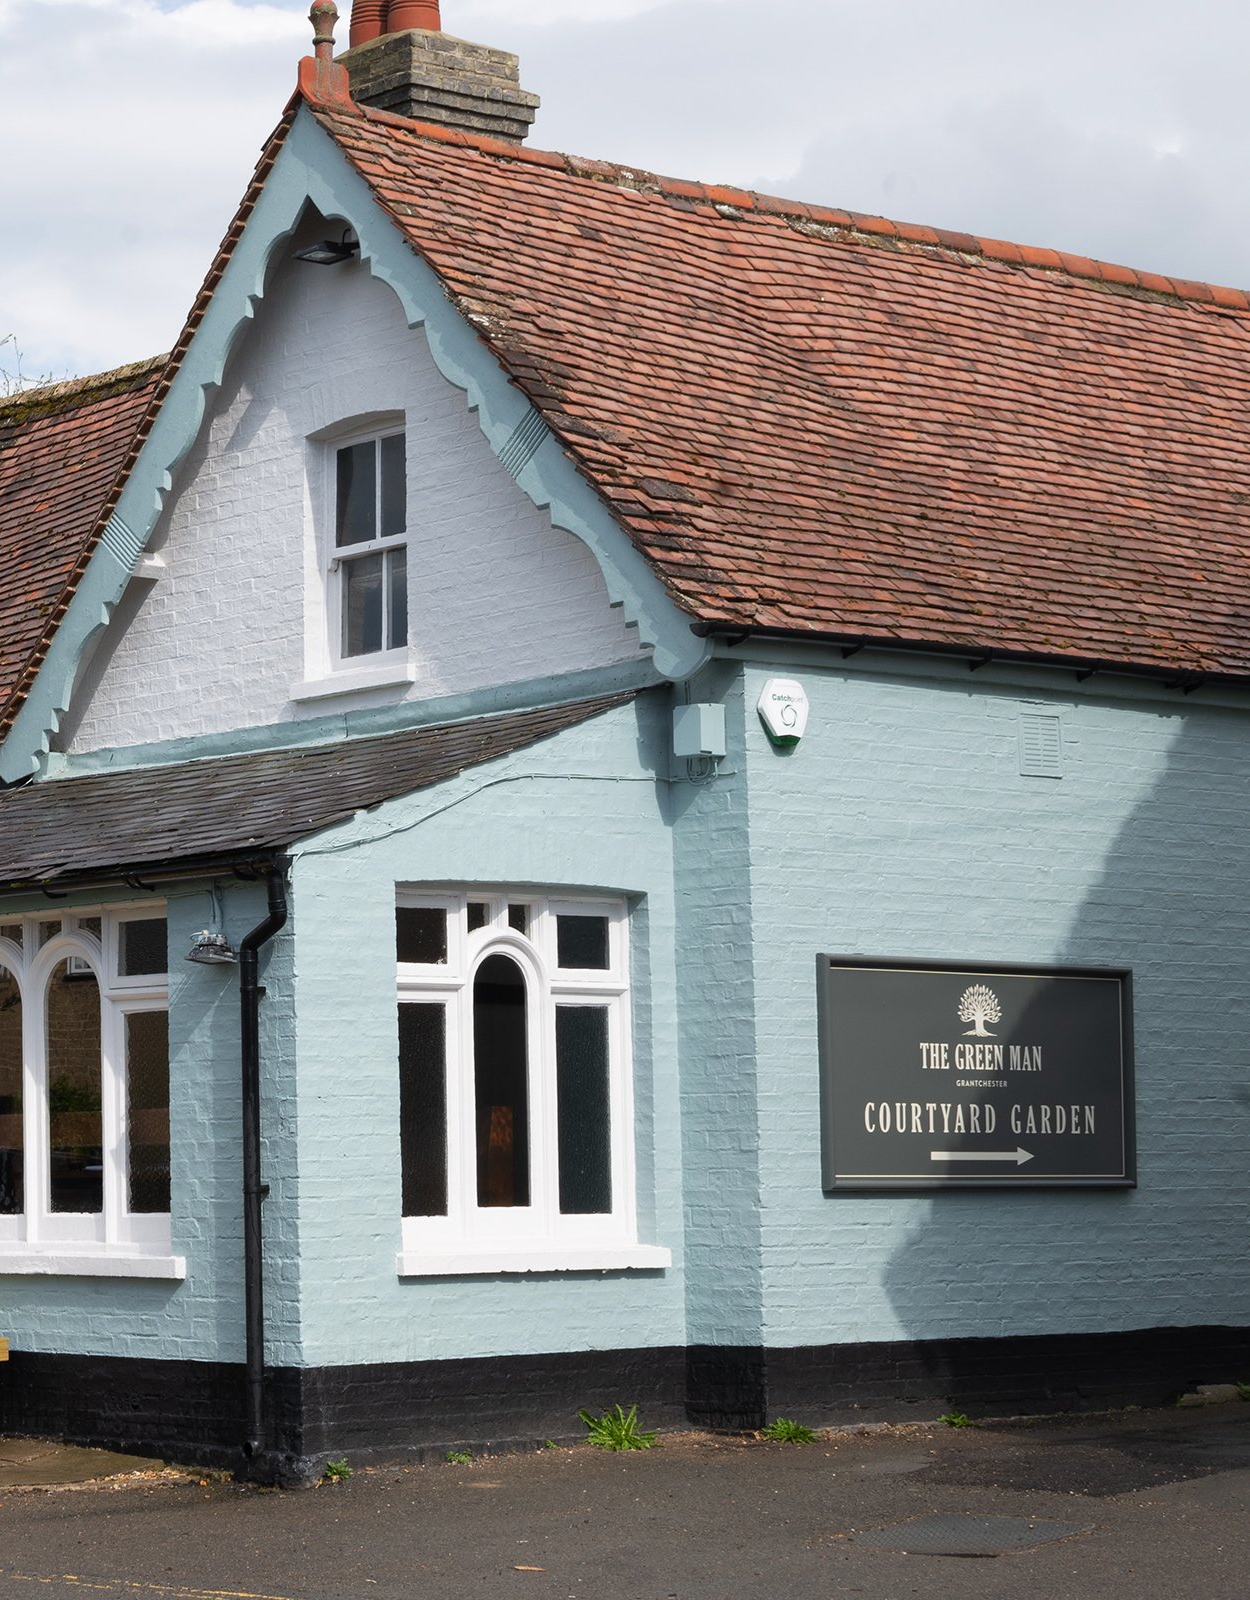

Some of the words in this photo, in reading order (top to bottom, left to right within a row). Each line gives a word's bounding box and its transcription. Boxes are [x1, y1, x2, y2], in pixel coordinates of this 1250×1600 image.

[919, 1042, 950, 1070] THE
[954, 1043, 1004, 1071] GREEN
[1009, 1045, 1042, 1072] MAN
[955, 1079, 1008, 1088] GRANTCHESTER
[864, 1101, 996, 1134] COURTYARD
[1010, 1103, 1096, 1135] GARDEN
